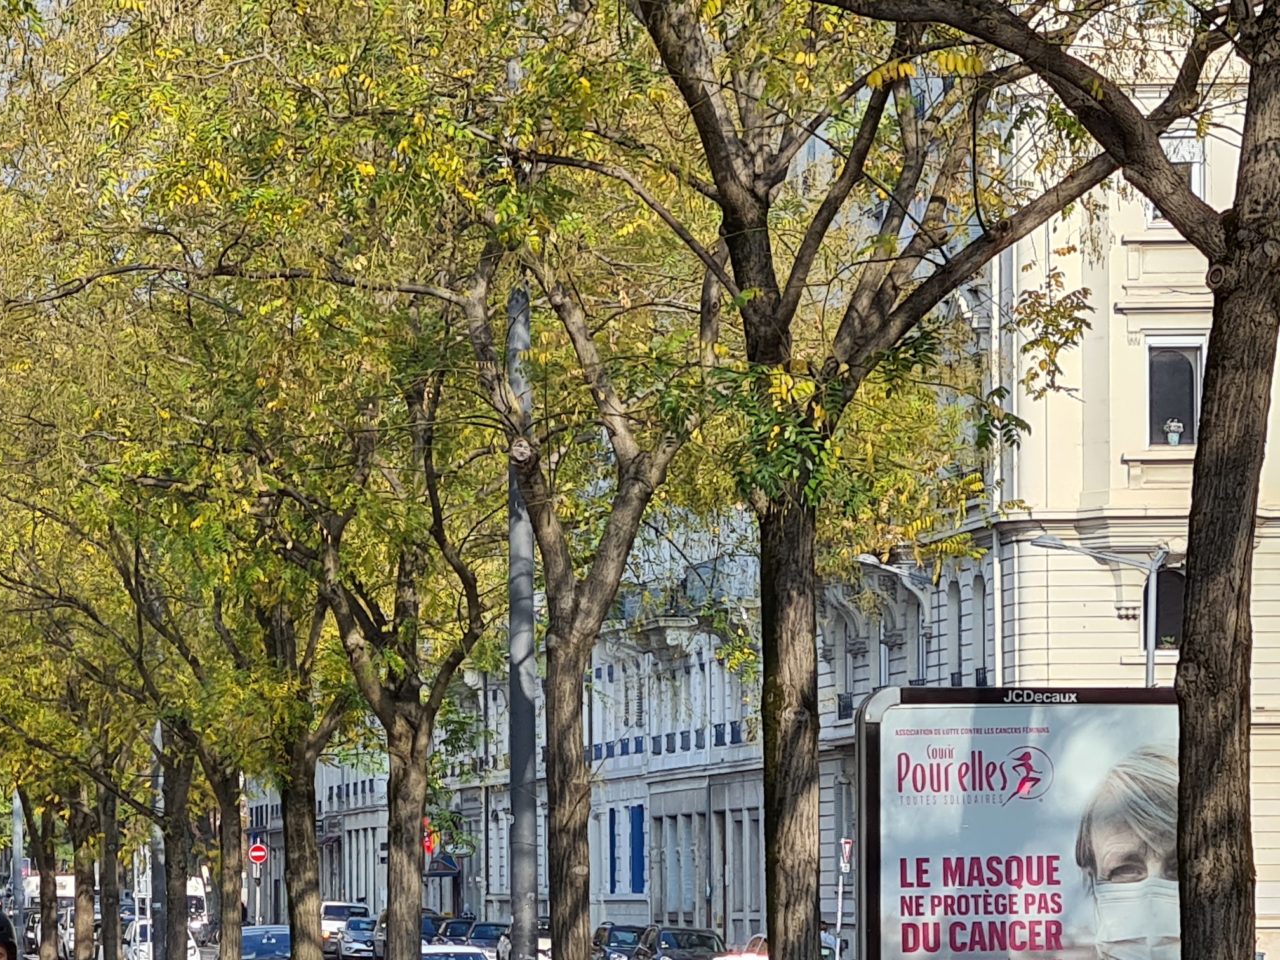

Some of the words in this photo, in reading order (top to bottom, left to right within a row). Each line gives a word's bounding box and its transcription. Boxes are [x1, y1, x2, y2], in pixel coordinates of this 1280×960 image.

[1003, 690, 1078, 703] JCDecaux
[926, 744, 955, 760] Courir
[899, 795, 937, 806] TOUTES
[943, 794, 1004, 805] SOLIDAIRES
[900, 857, 931, 888] LE
[942, 855, 1061, 890] MASQUE
[900, 895, 925, 917] NE
[930, 889, 1019, 916] PROTÈGE
[1024, 892, 1063, 914] PAS
[901, 922, 941, 953] DU
[949, 920, 1064, 953] CANCER
